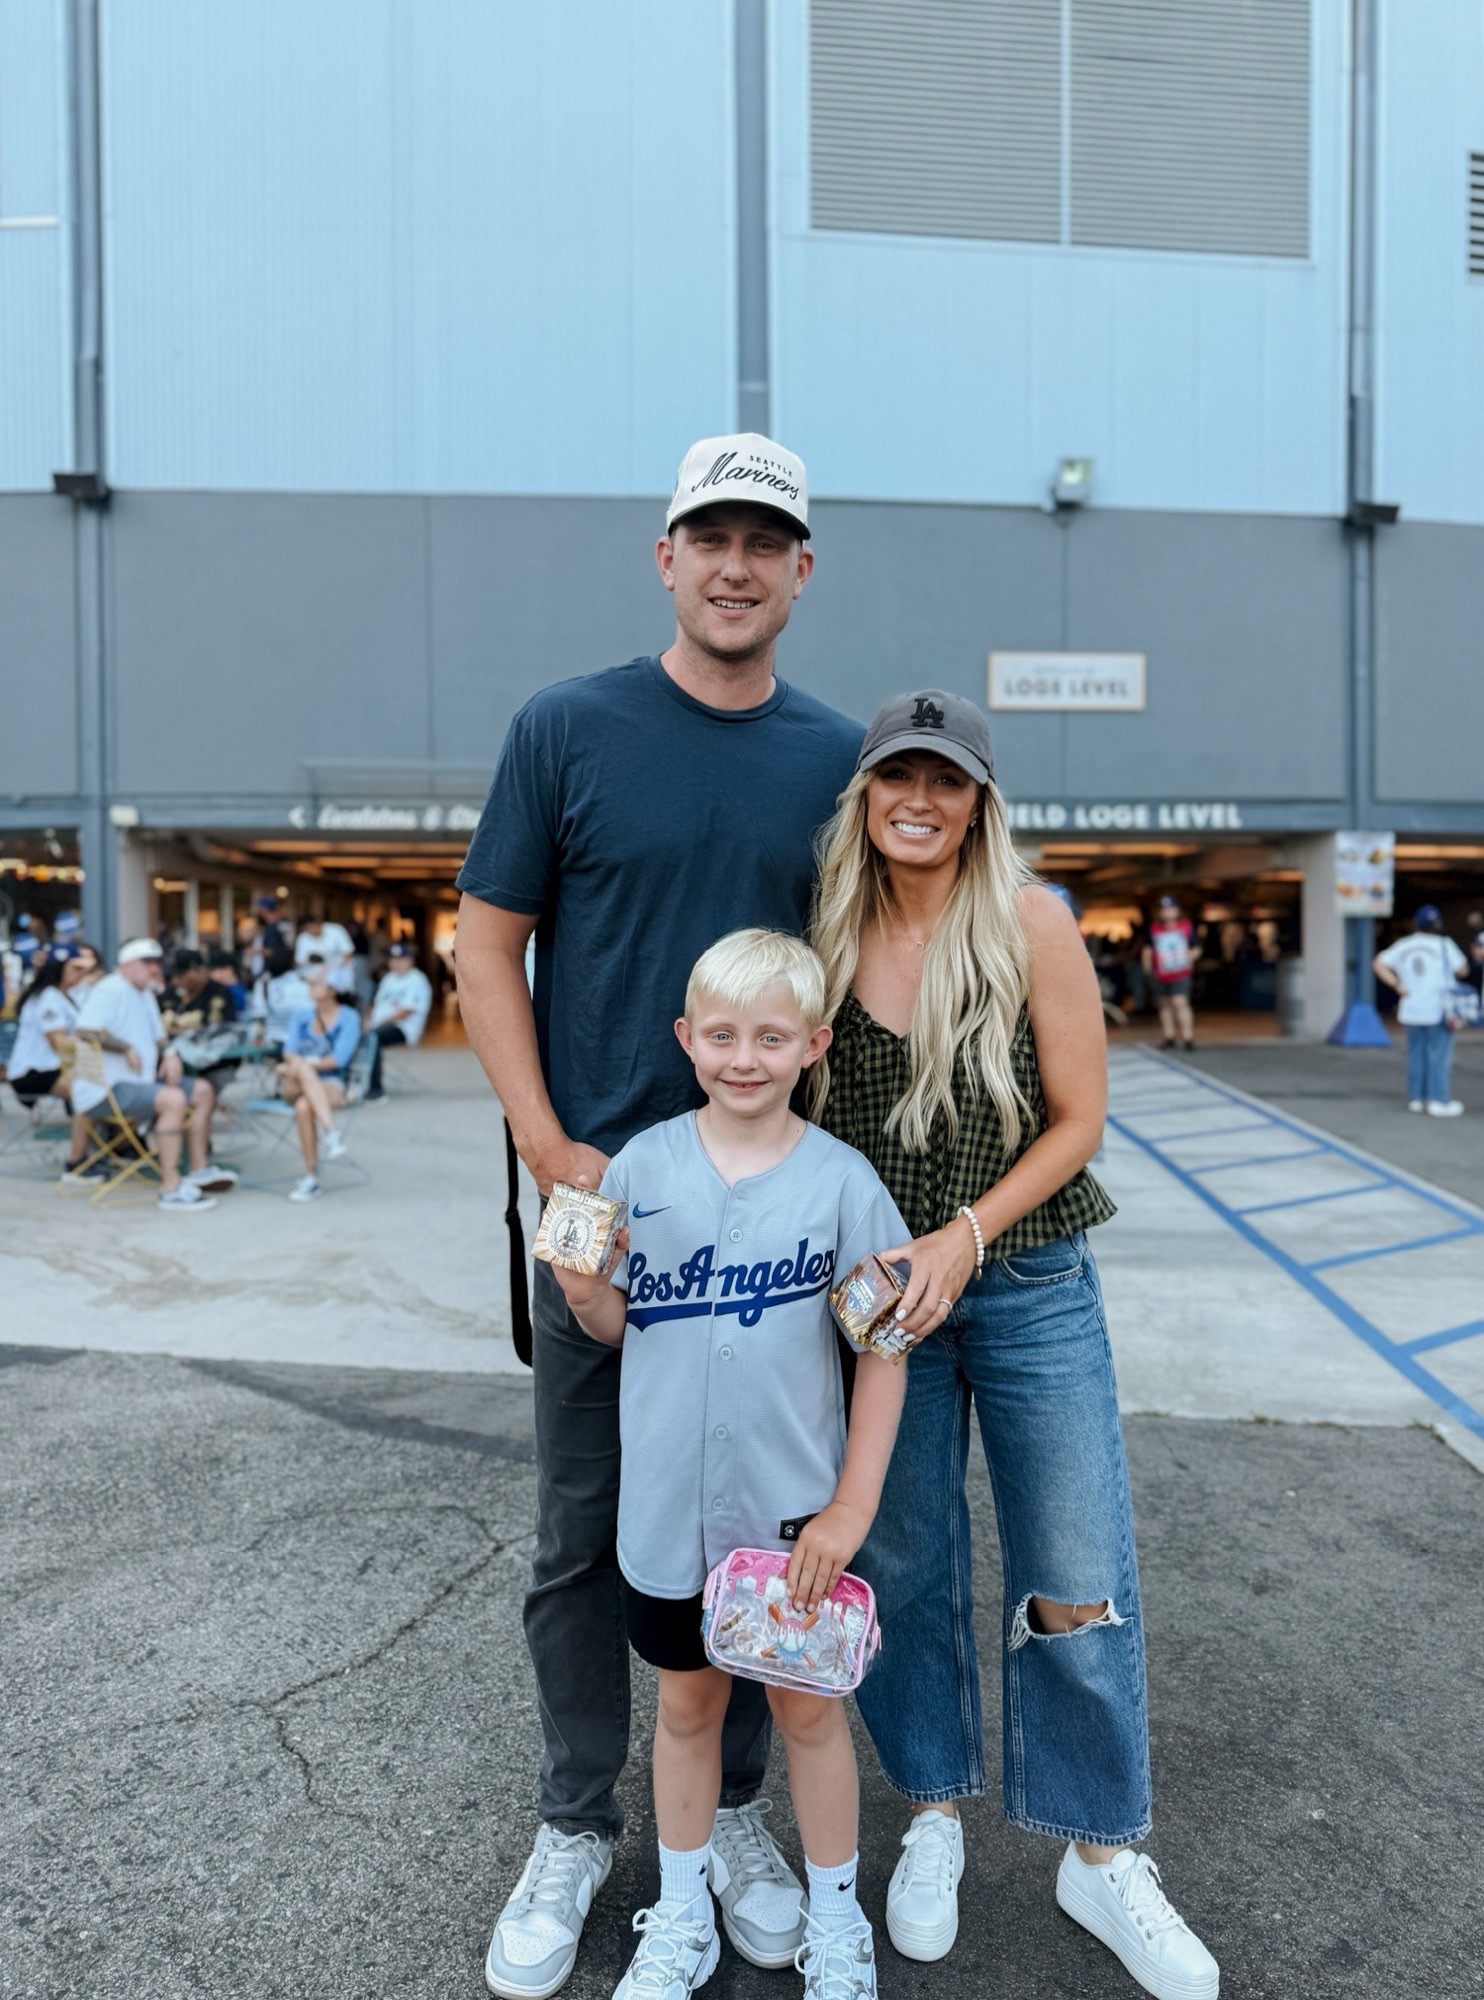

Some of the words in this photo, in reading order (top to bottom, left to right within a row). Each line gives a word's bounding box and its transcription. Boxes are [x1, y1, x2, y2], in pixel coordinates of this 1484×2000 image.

[691, 451, 800, 500] Mariners
[750, 455, 792, 477] SEATTLE
[1004, 678, 1061, 697] LOGE
[1069, 678, 1128, 697] LEVEL
[910, 698, 945, 729] LA
[1074, 804, 1149, 830] LOGE
[1157, 804, 1242, 830] LEVEL
